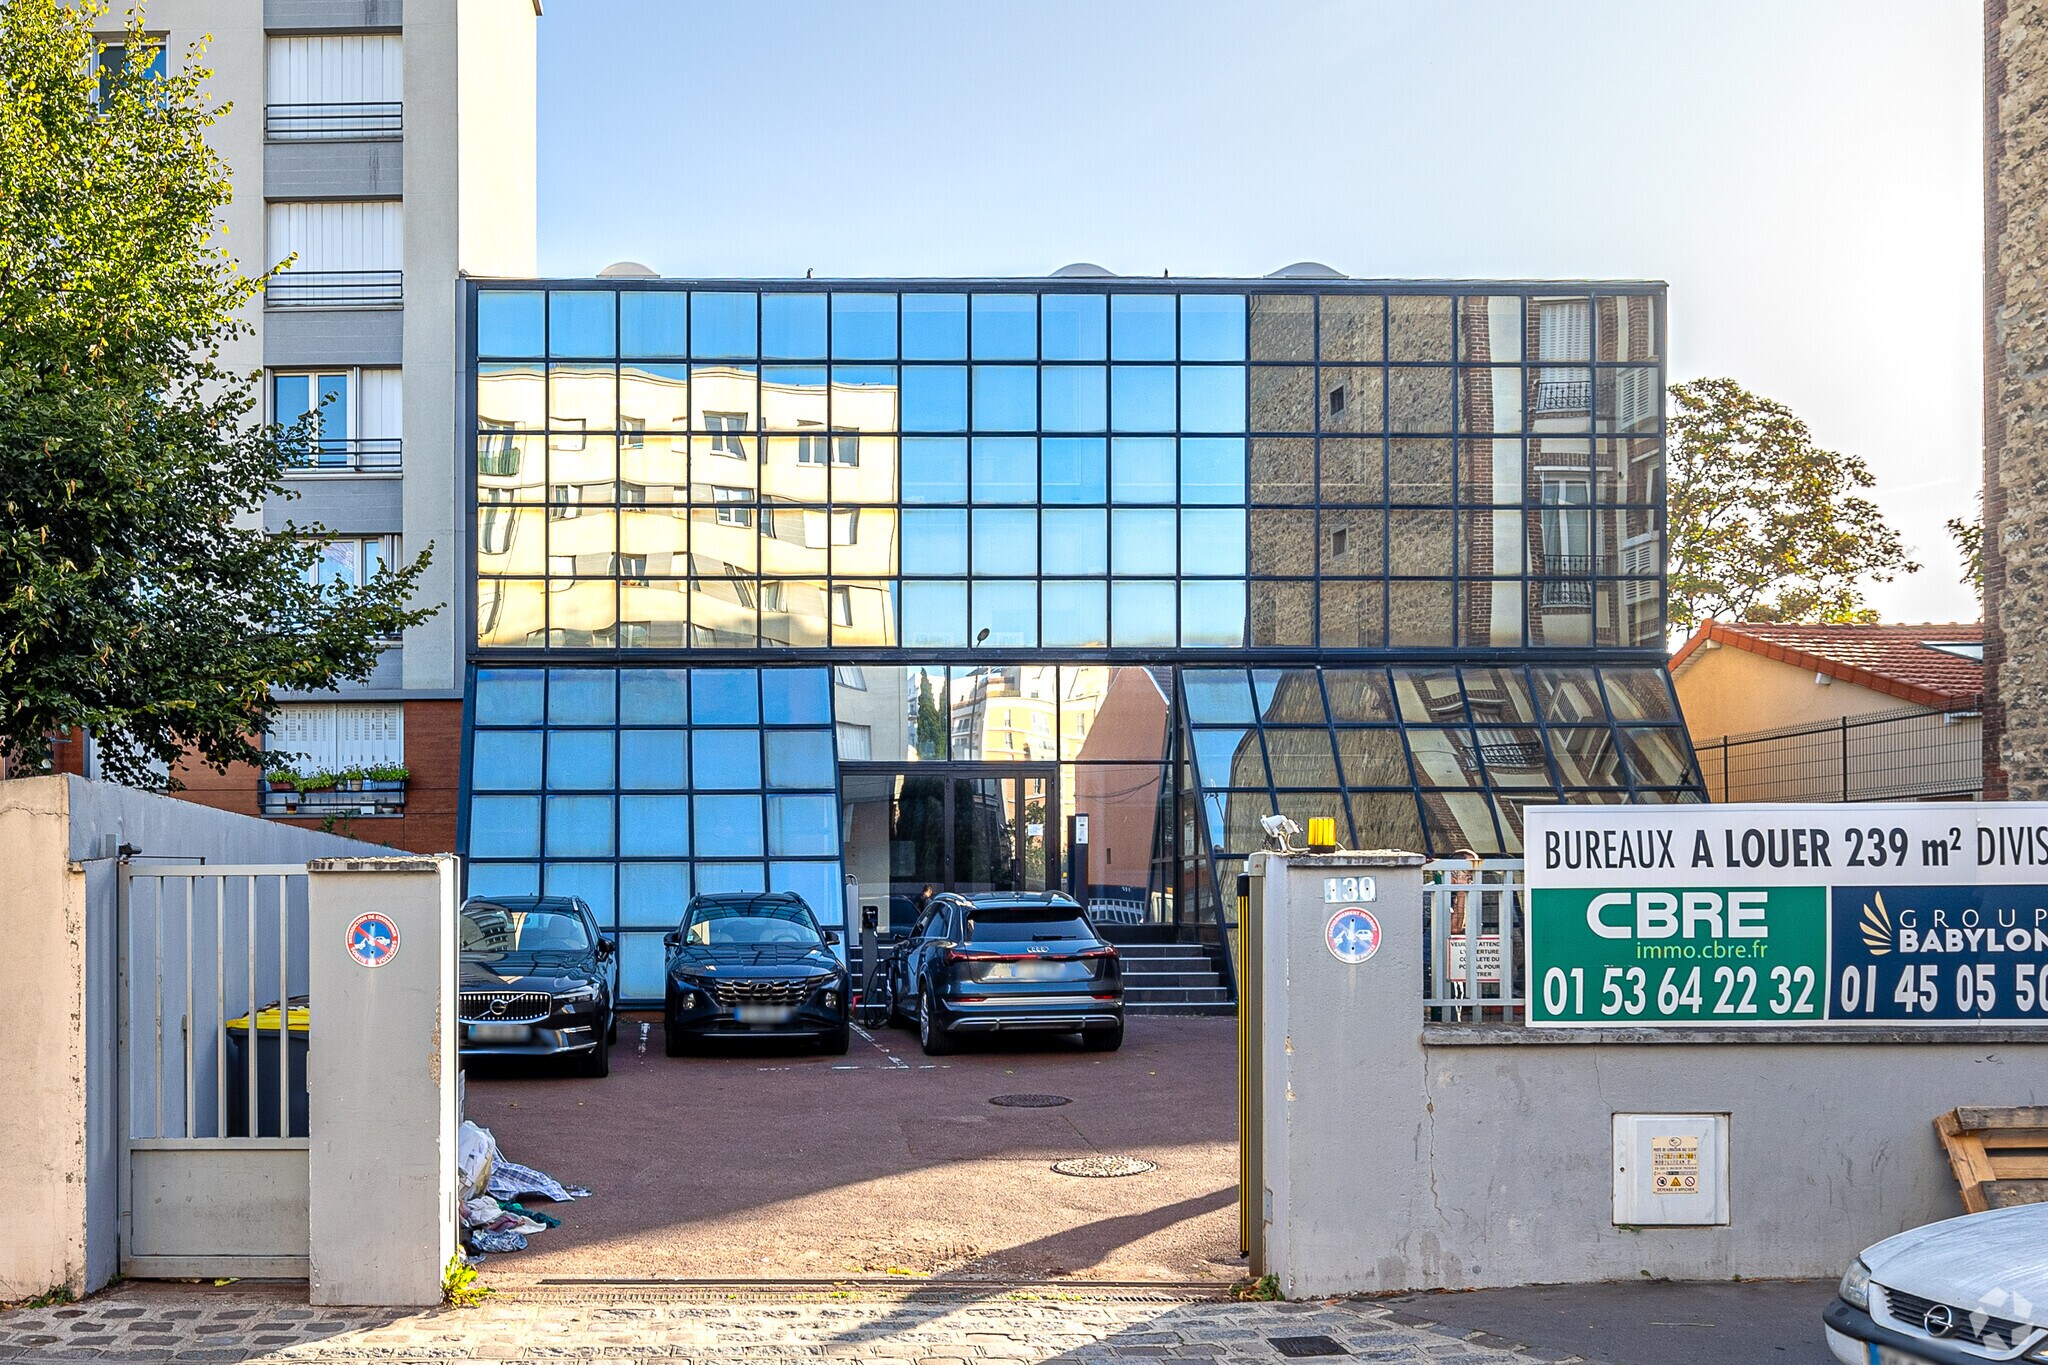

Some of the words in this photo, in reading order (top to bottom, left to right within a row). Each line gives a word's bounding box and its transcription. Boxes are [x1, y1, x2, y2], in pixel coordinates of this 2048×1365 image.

[1545, 830, 1675, 869] BUREAUX
[1691, 829, 1714, 868] A
[1725, 828, 1832, 868] LOUER
[1844, 827, 1908, 867] 239
[1921, 827, 1962, 866] m²
[1327, 877, 1376, 902] 130
[1586, 891, 1768, 939] CBRE
[1899, 908, 2048, 928] GROUP
[350, 946, 367, 964] SORTIE
[377, 940, 397, 964] VOITURES
[1636, 939, 1768, 959] immo.cbre.fr
[1543, 966, 1584, 1016] 01
[1600, 966, 1647, 1015] 53
[1657, 966, 1703, 1015] 64
[1712, 965, 1758, 1014] 22
[1769, 965, 1815, 1014] 32
[1840, 965, 1877, 1013] 01
[1894, 964, 1938, 1013] 45
[1956, 964, 1996, 1012] 05
